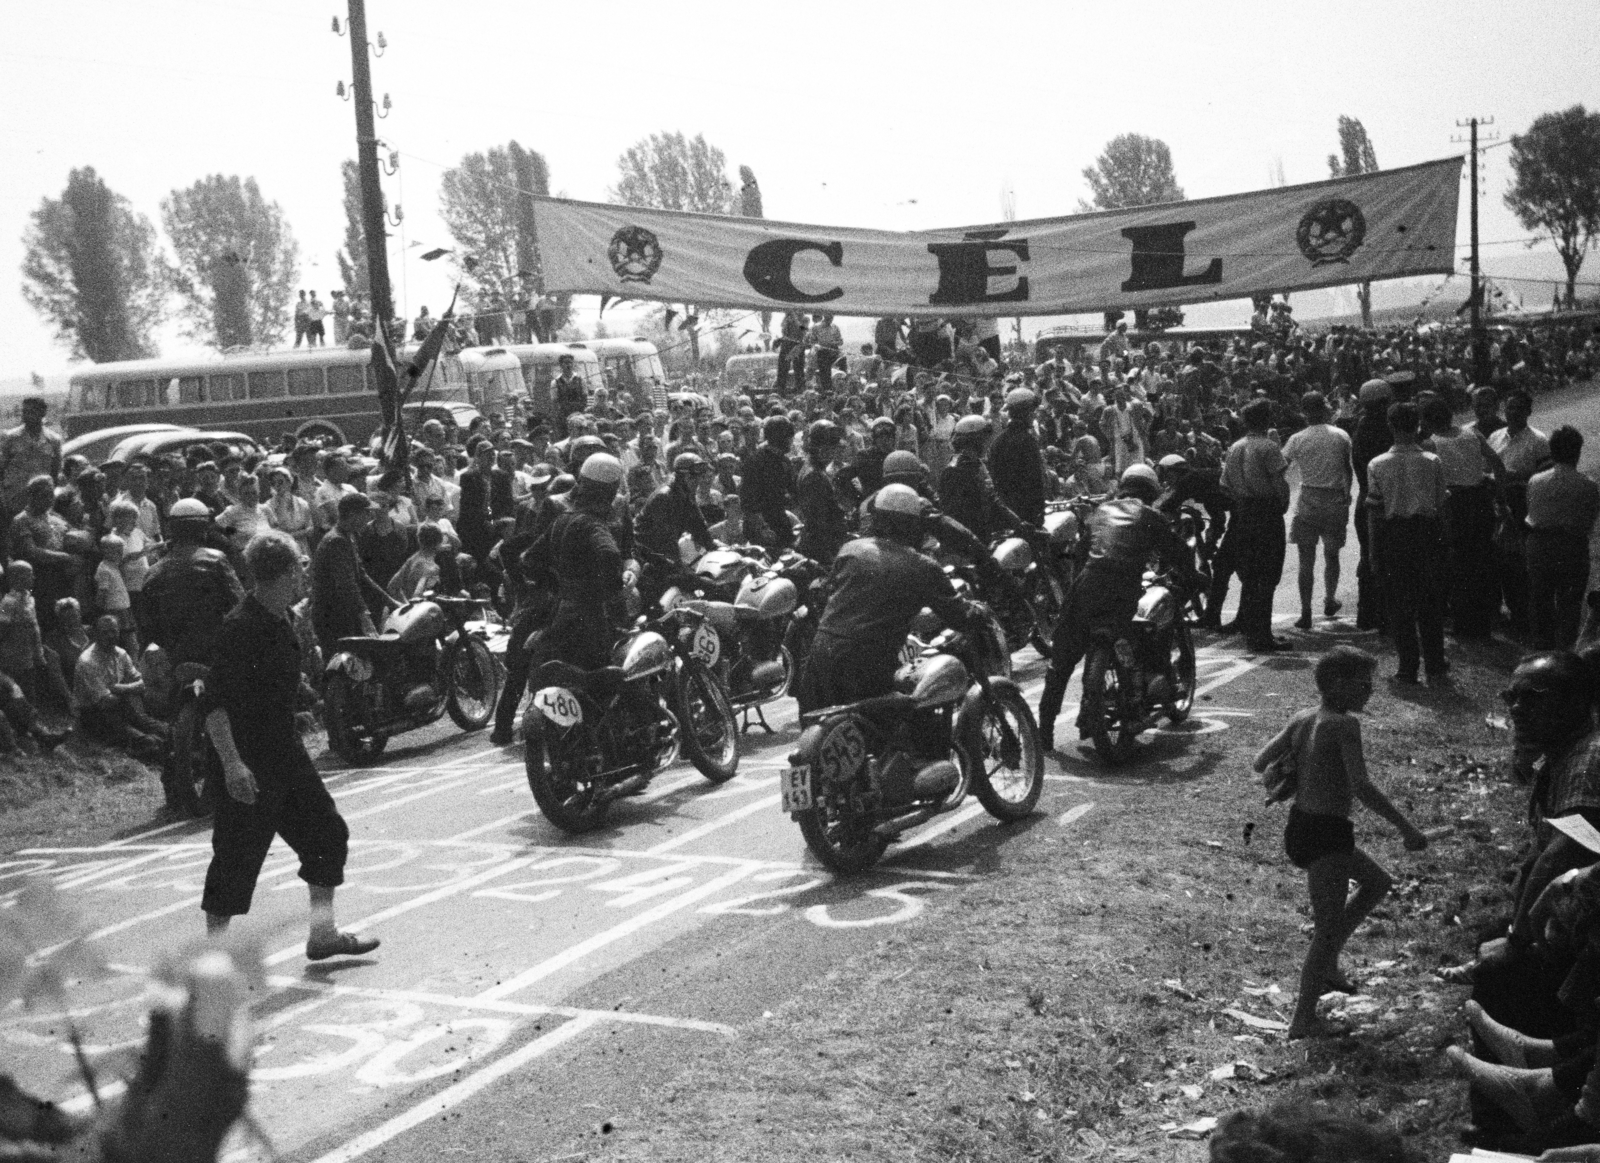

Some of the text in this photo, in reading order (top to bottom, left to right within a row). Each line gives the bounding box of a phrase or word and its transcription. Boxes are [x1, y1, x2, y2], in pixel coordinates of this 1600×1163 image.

[743, 221, 1223, 306] CÉL
[544, 693, 580, 718] 480
[820, 724, 862, 780] 545
